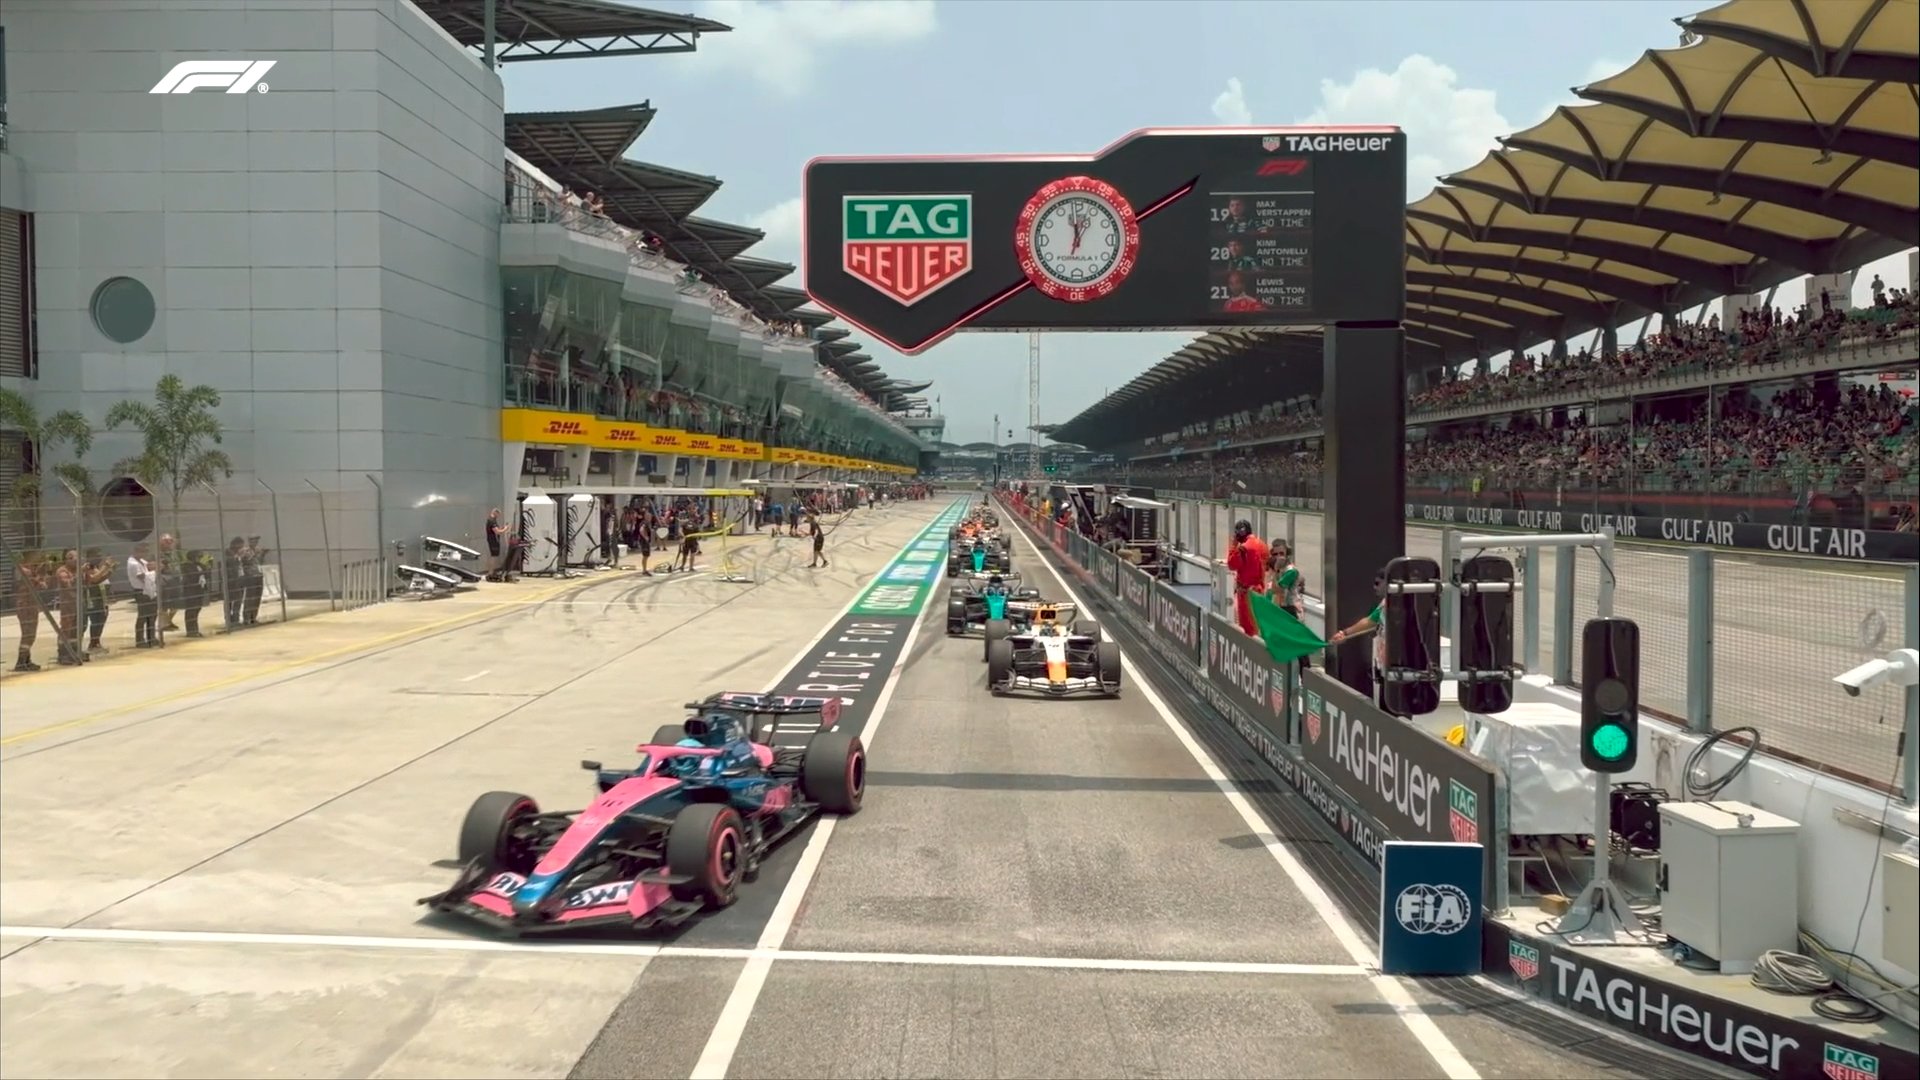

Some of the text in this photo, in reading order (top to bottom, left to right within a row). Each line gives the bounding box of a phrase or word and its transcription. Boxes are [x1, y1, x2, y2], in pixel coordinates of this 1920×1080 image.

[1256, 200, 1276, 208] MAX
[854, 203, 958, 234] TAG
[1210, 208, 1230, 221] 19
[1256, 208, 1312, 217] VERSTAPPEN
[1280, 218, 1304, 228] TIME
[1256, 239, 1277, 247] KIMI
[1210, 247, 1230, 260] 20
[1256, 248, 1308, 256] ANTONELLI
[1262, 257, 1304, 267] NO TIME
[852, 246, 963, 296] HEUER
[1256, 278, 1284, 286] LEWIS
[1210, 286, 1230, 299] 21
[1256, 287, 1306, 295] HAMILTON
[1262, 296, 1304, 306] NO TIME
[549, 421, 582, 435] DHL
[610, 429, 636, 441] DHL
[655, 435, 677, 446] DHL
[691, 440, 710, 449] DHL
[1424, 505, 1455, 521] GULF AIR
[1467, 507, 1503, 526] GULF AIR
[1518, 510, 1562, 531] GULF AIR
[1615, 515, 1637, 536] AIR
[1661, 518, 1734, 546] GULF AIR
[1767, 524, 1866, 558] GULF AIR
[797, 651, 881, 705] RIVE
[839, 622, 898, 644] FOR
[1452, 784, 1475, 819] TAG
[1512, 943, 1536, 961] TAG
[1829, 1046, 1873, 1072] TAG
